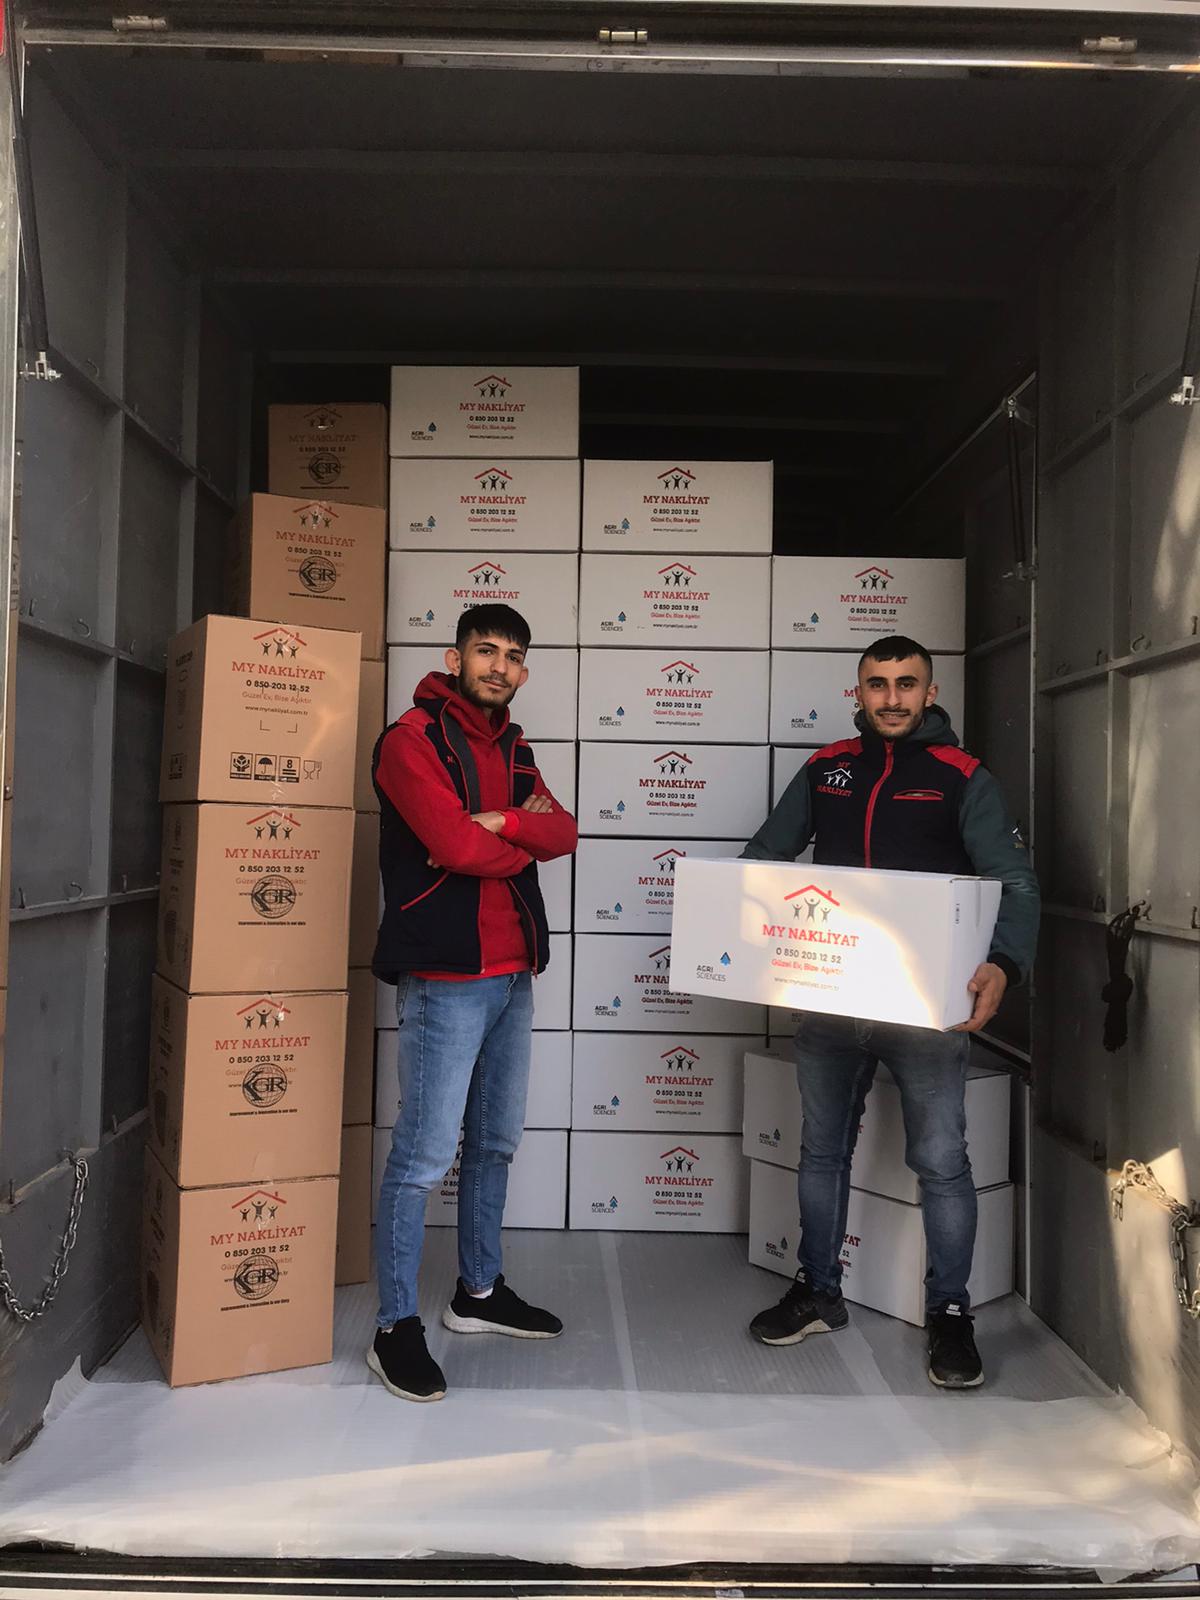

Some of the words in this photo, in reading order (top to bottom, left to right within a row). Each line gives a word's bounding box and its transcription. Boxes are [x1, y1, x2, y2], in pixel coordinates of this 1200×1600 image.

[478, 402, 526, 411] NAKLİYAT
[479, 494, 527, 504] NAKLİYAT
[662, 494, 710, 504] NAKLİYAT
[276, 531, 295, 540] MY
[299, 534, 355, 547] NAKLİYAT
[472, 589, 519, 598] NAKLİYAT
[662, 590, 710, 600] NAKLİYAT
[859, 594, 908, 604] NAKLİYAT
[232, 661, 255, 673] MY
[258, 664, 325, 680] NAKLİYAT
[665, 688, 713, 698] NAKLİYAT
[287, 759, 292, 768] 8
[658, 778, 706, 788] NAKLİYAT
[225, 848, 248, 858] MY
[253, 847, 320, 859] NAKLİYAT
[763, 924, 785, 938] MY
[788, 928, 859, 946] NAKLİYAT
[784, 948, 799, 957] 850
[802, 951, 817, 960] 203
[831, 956, 841, 964] 52
[635, 975, 651, 983] MY
[696, 973, 726, 982] SCIENCES
[215, 1040, 238, 1050] MY
[242, 1035, 310, 1048] NAKLİYAT
[646, 1076, 663, 1084] MY
[665, 1075, 714, 1086] NAKLİYAT
[646, 1177, 662, 1185] MY
[664, 1176, 714, 1186] NAKLİYAT
[211, 1234, 234, 1245] MY
[237, 1226, 306, 1243] NAKLİYAT
